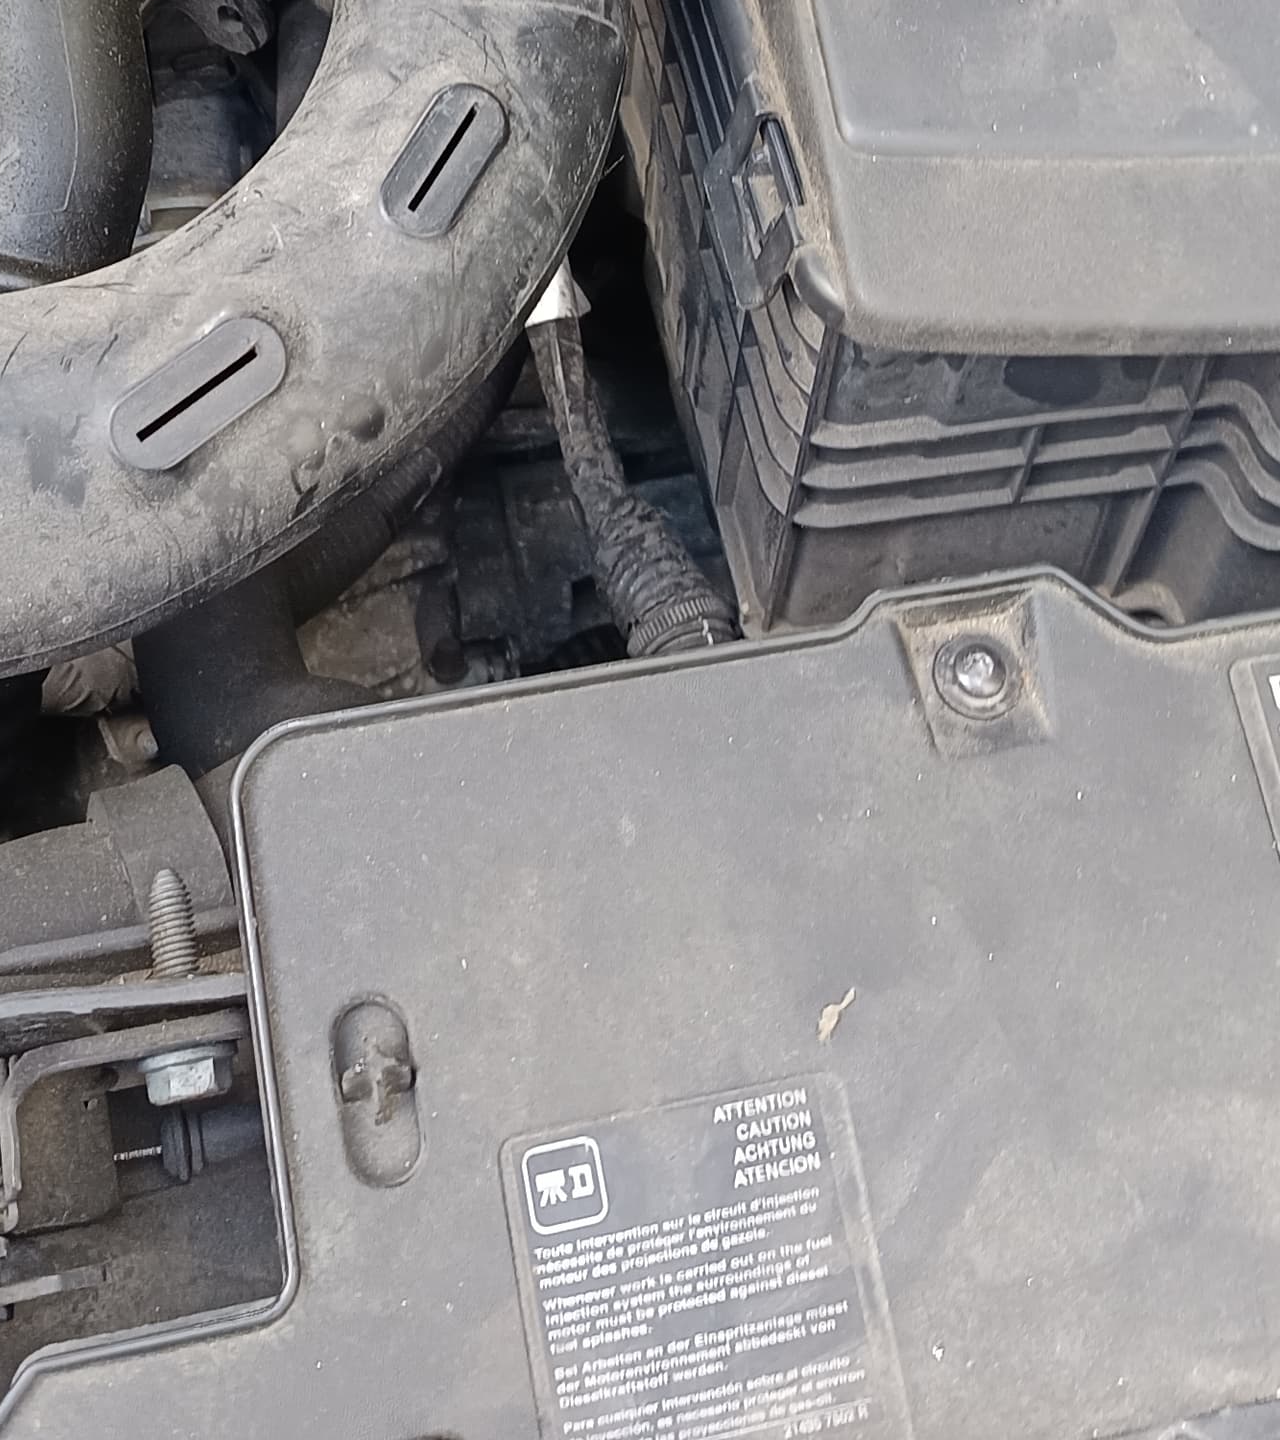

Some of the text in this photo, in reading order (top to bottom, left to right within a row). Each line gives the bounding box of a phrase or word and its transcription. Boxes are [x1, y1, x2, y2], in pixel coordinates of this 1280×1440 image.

[713, 1089, 807, 1123] ATTENTION
[736, 1110, 812, 1141] CAUTION
[734, 1131, 816, 1164] ACHTUNG
